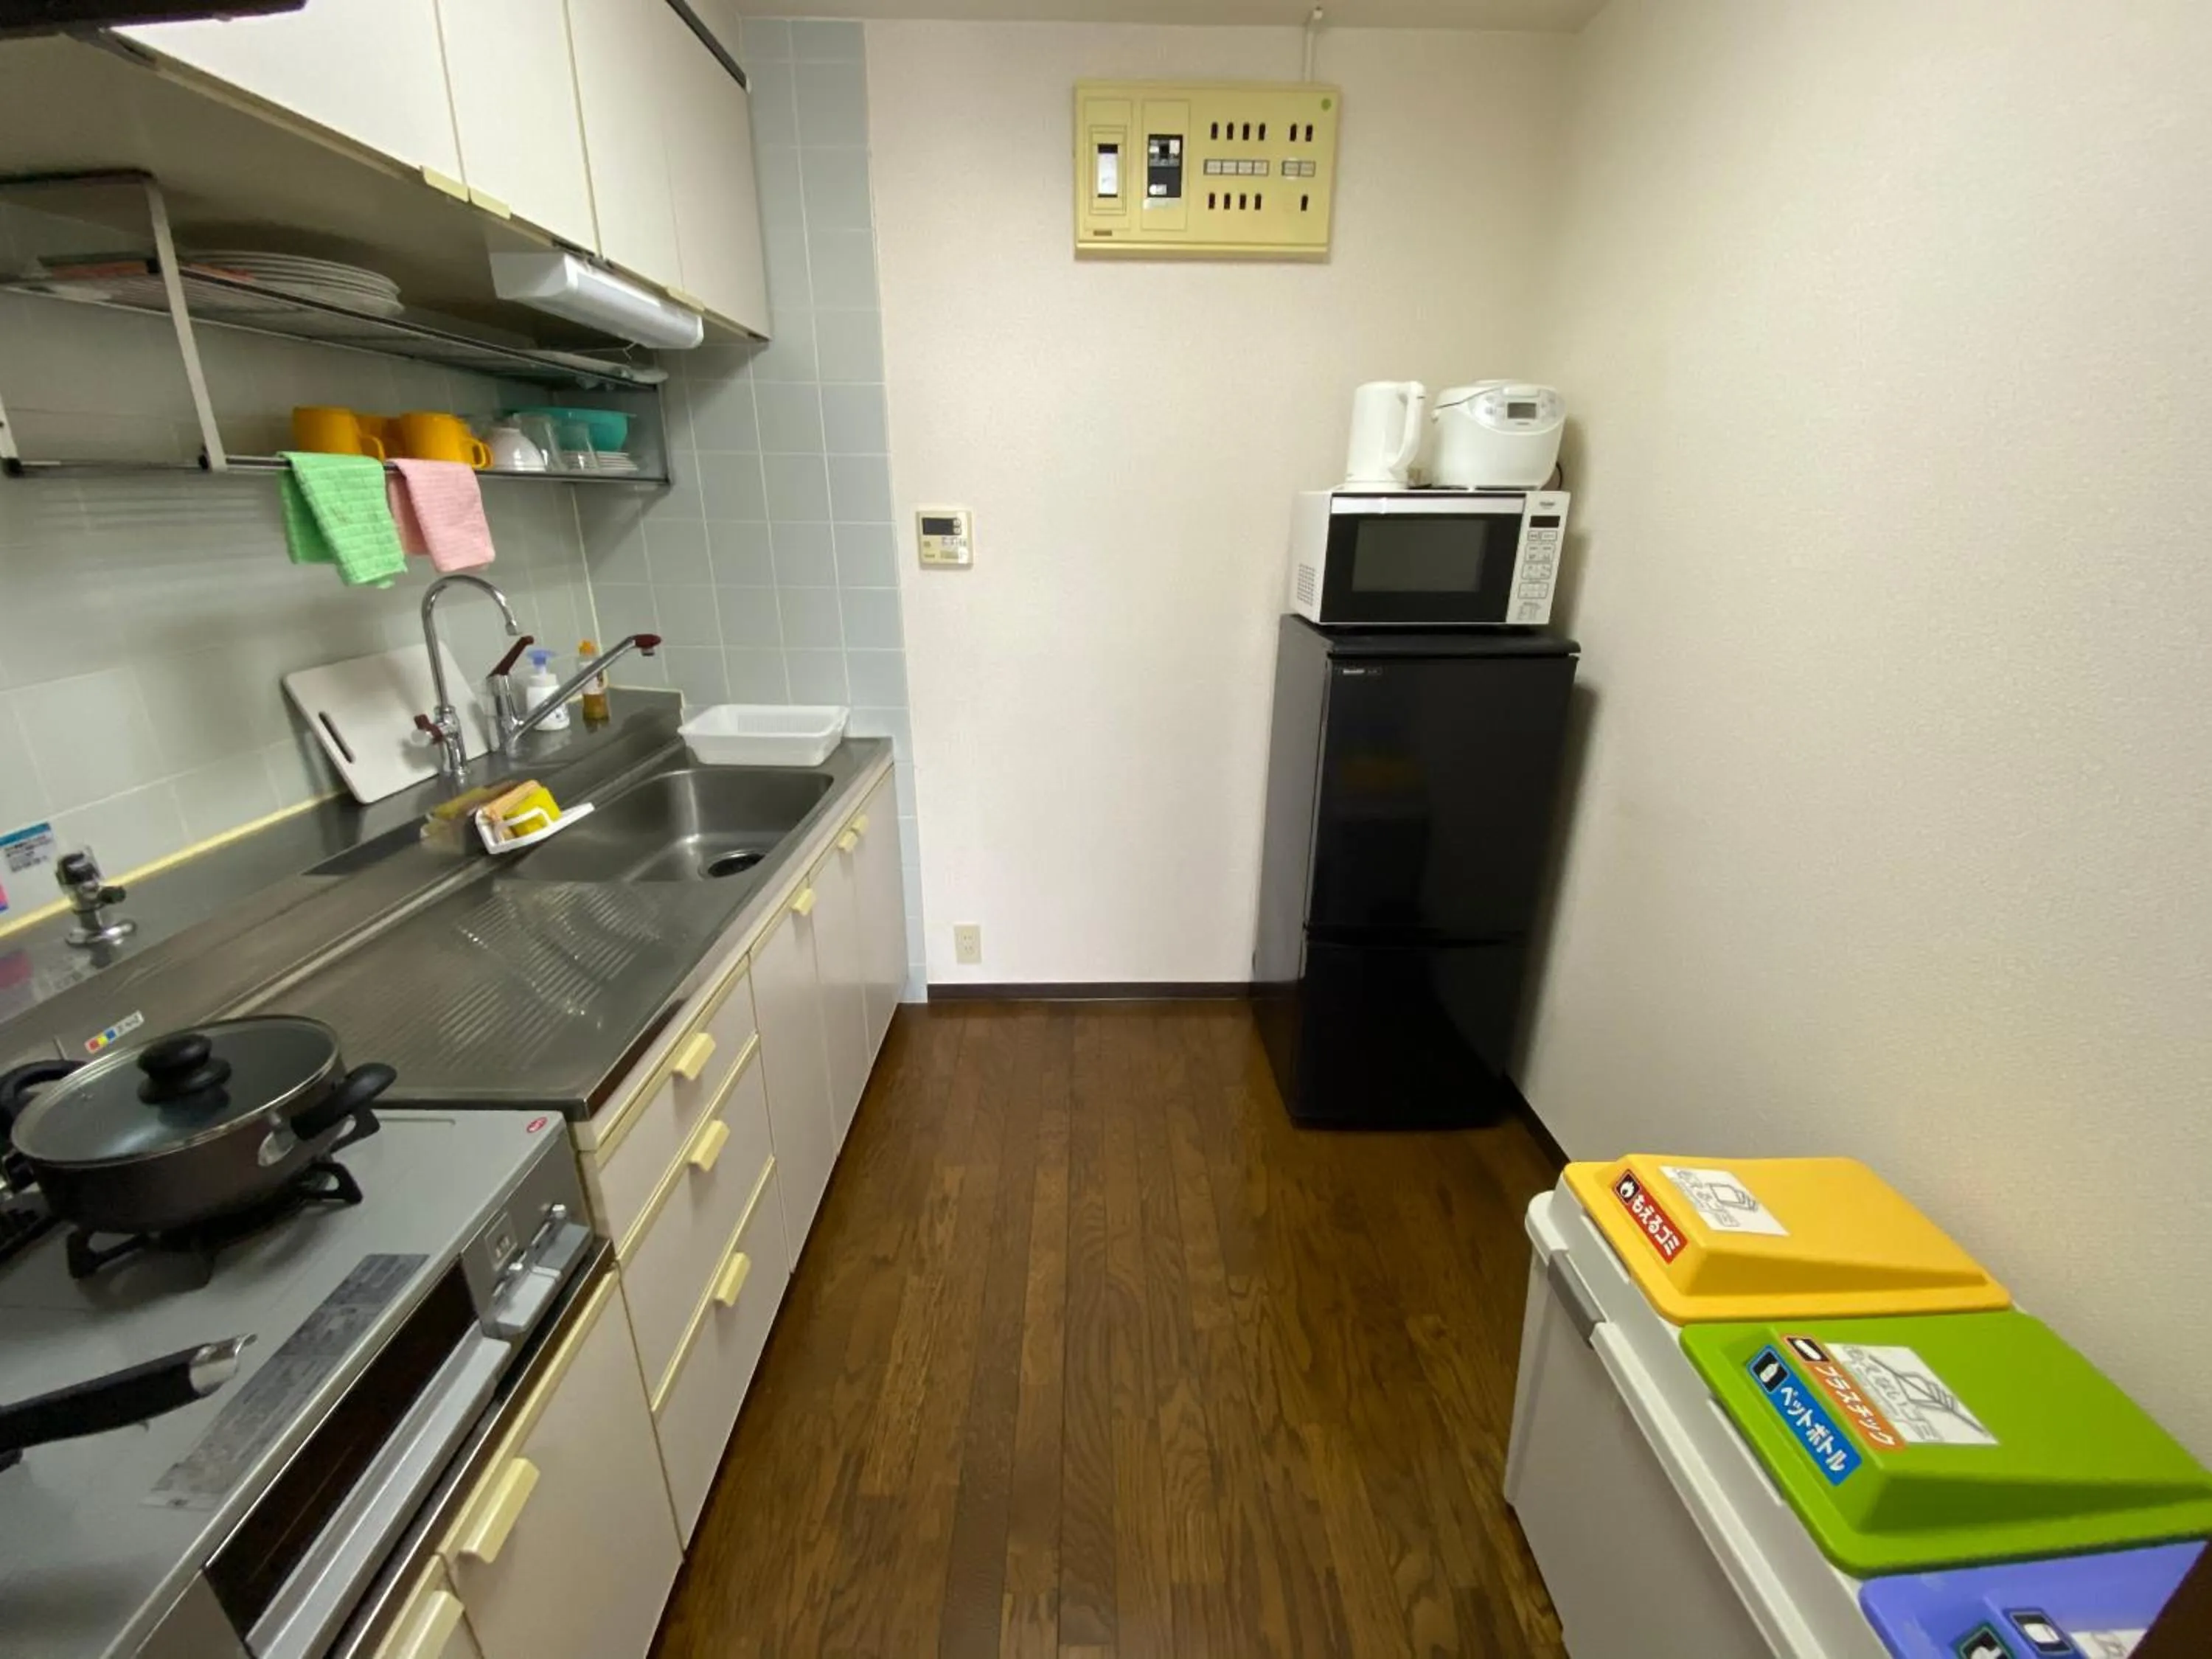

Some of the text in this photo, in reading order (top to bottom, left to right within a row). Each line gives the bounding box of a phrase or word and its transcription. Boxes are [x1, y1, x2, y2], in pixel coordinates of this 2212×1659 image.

[1632, 1194, 1681, 1256] もえるゴミ
[1781, 1386, 1848, 1472] ペットボトル
[1815, 1365, 1896, 1446] プラスチック
